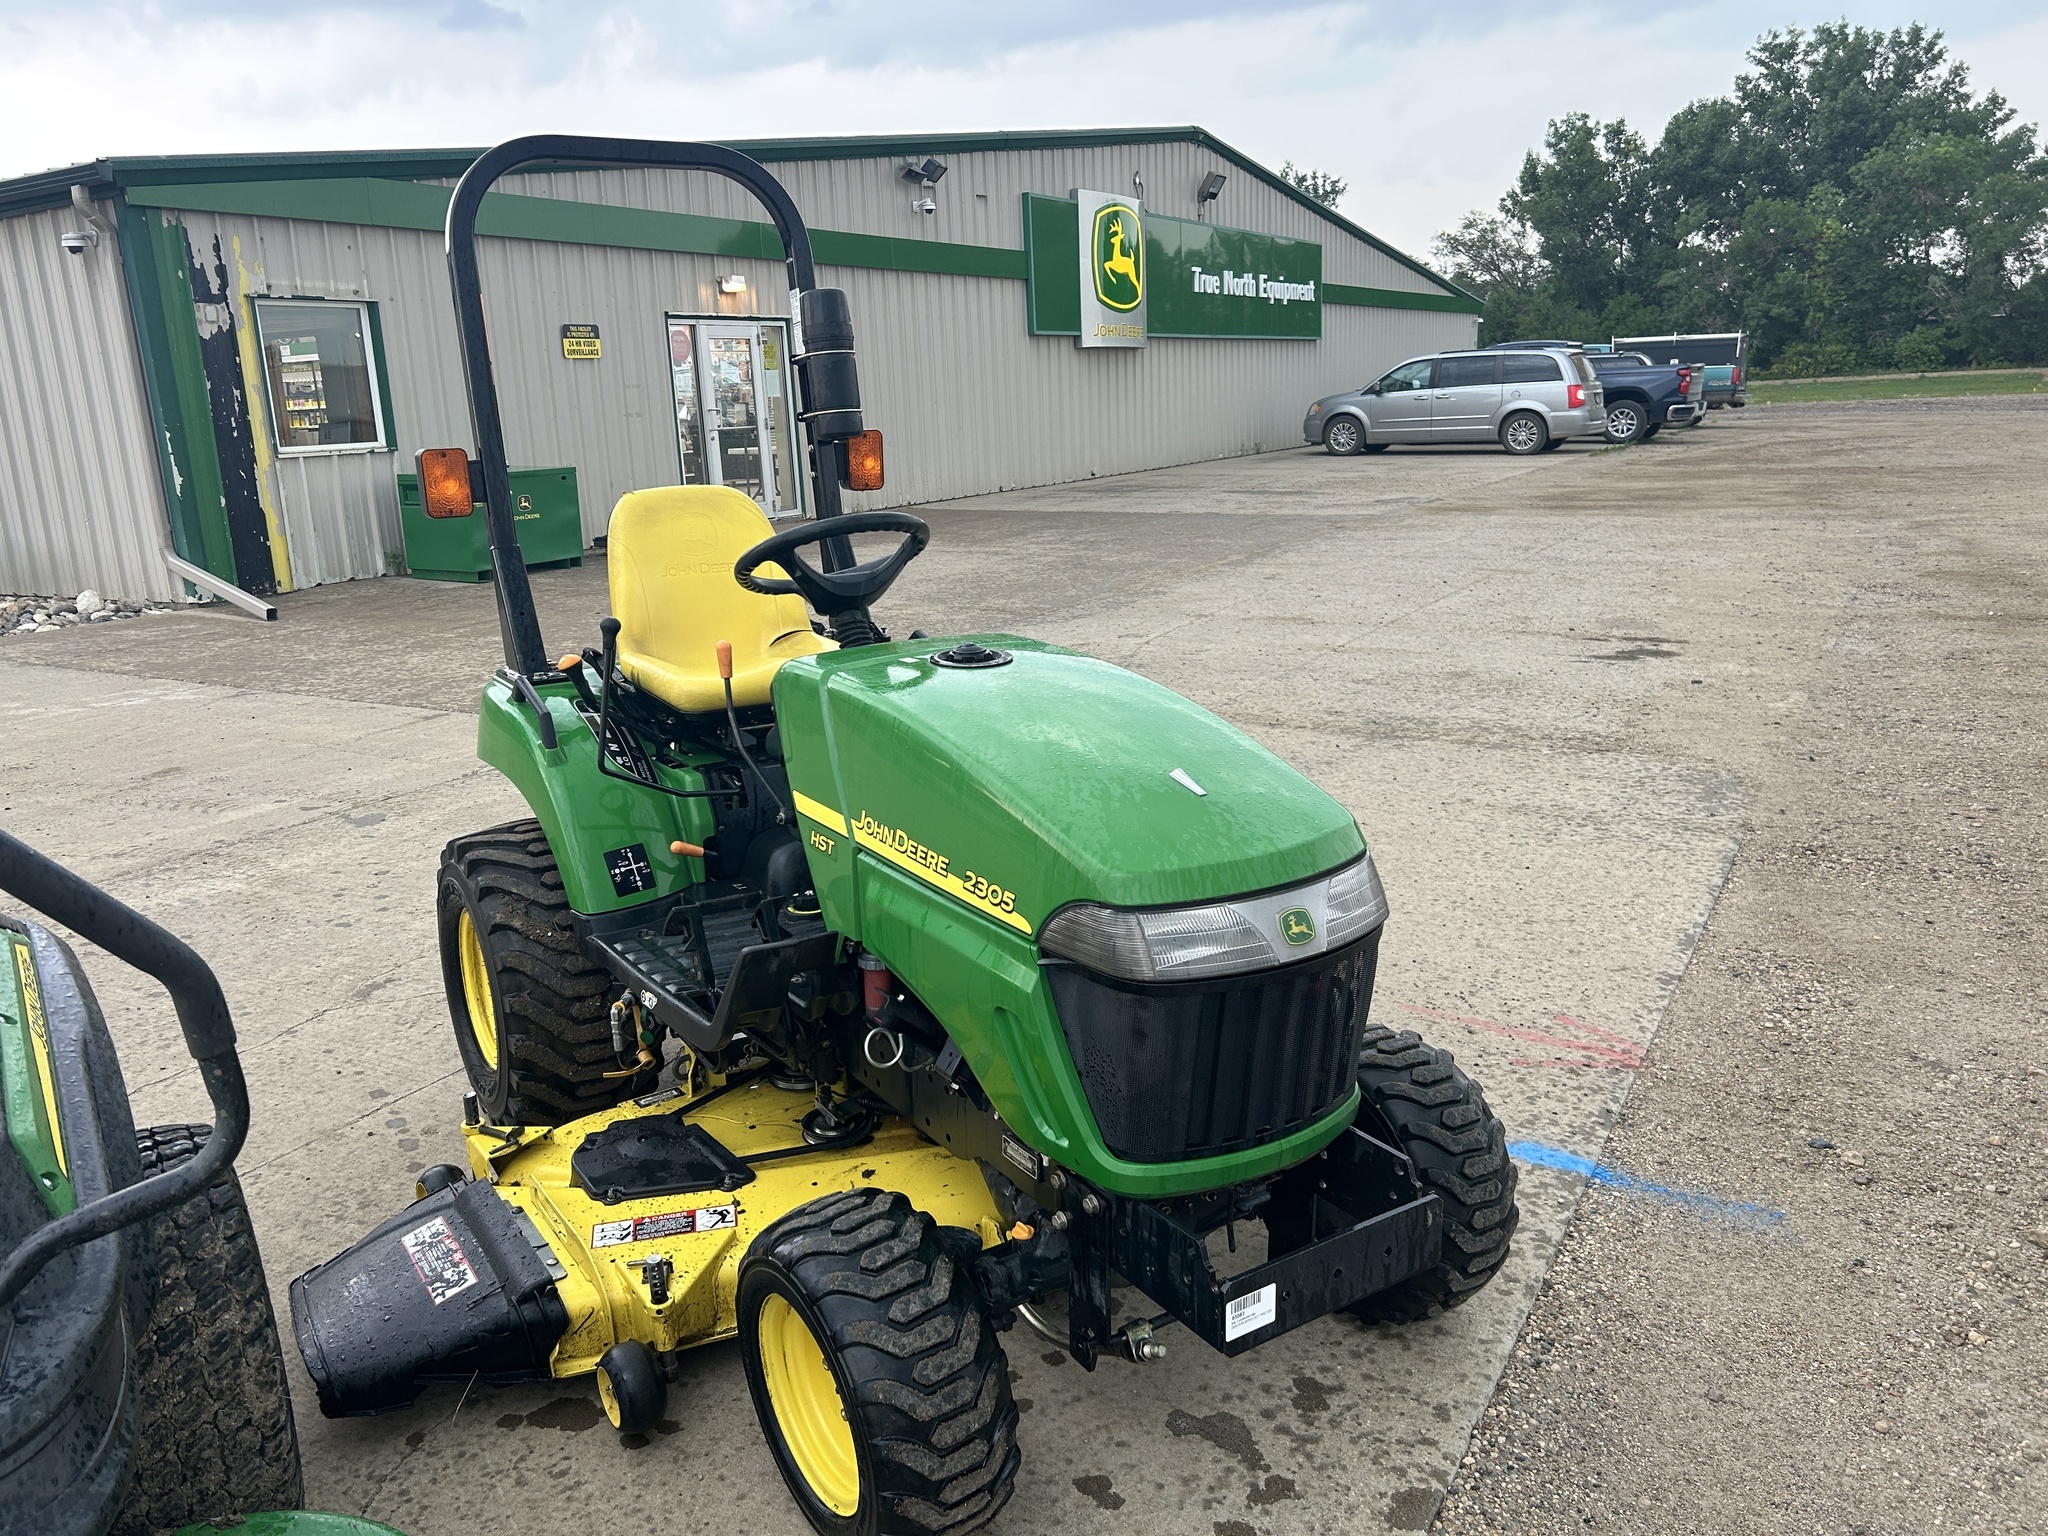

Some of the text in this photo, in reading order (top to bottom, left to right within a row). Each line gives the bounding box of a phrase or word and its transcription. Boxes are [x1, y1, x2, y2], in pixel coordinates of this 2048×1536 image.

[1192, 266, 1315, 305] True North Equipment
[1092, 322, 1144, 339] JOHN DEERE
[661, 562, 735, 578] JOHN DEER
[810, 830, 835, 856] HST
[855, 809, 1016, 914] JOHN DEERE 2305
[21, 957, 48, 1052] JOHN DEERE
[652, 1212, 687, 1221] DANGER
